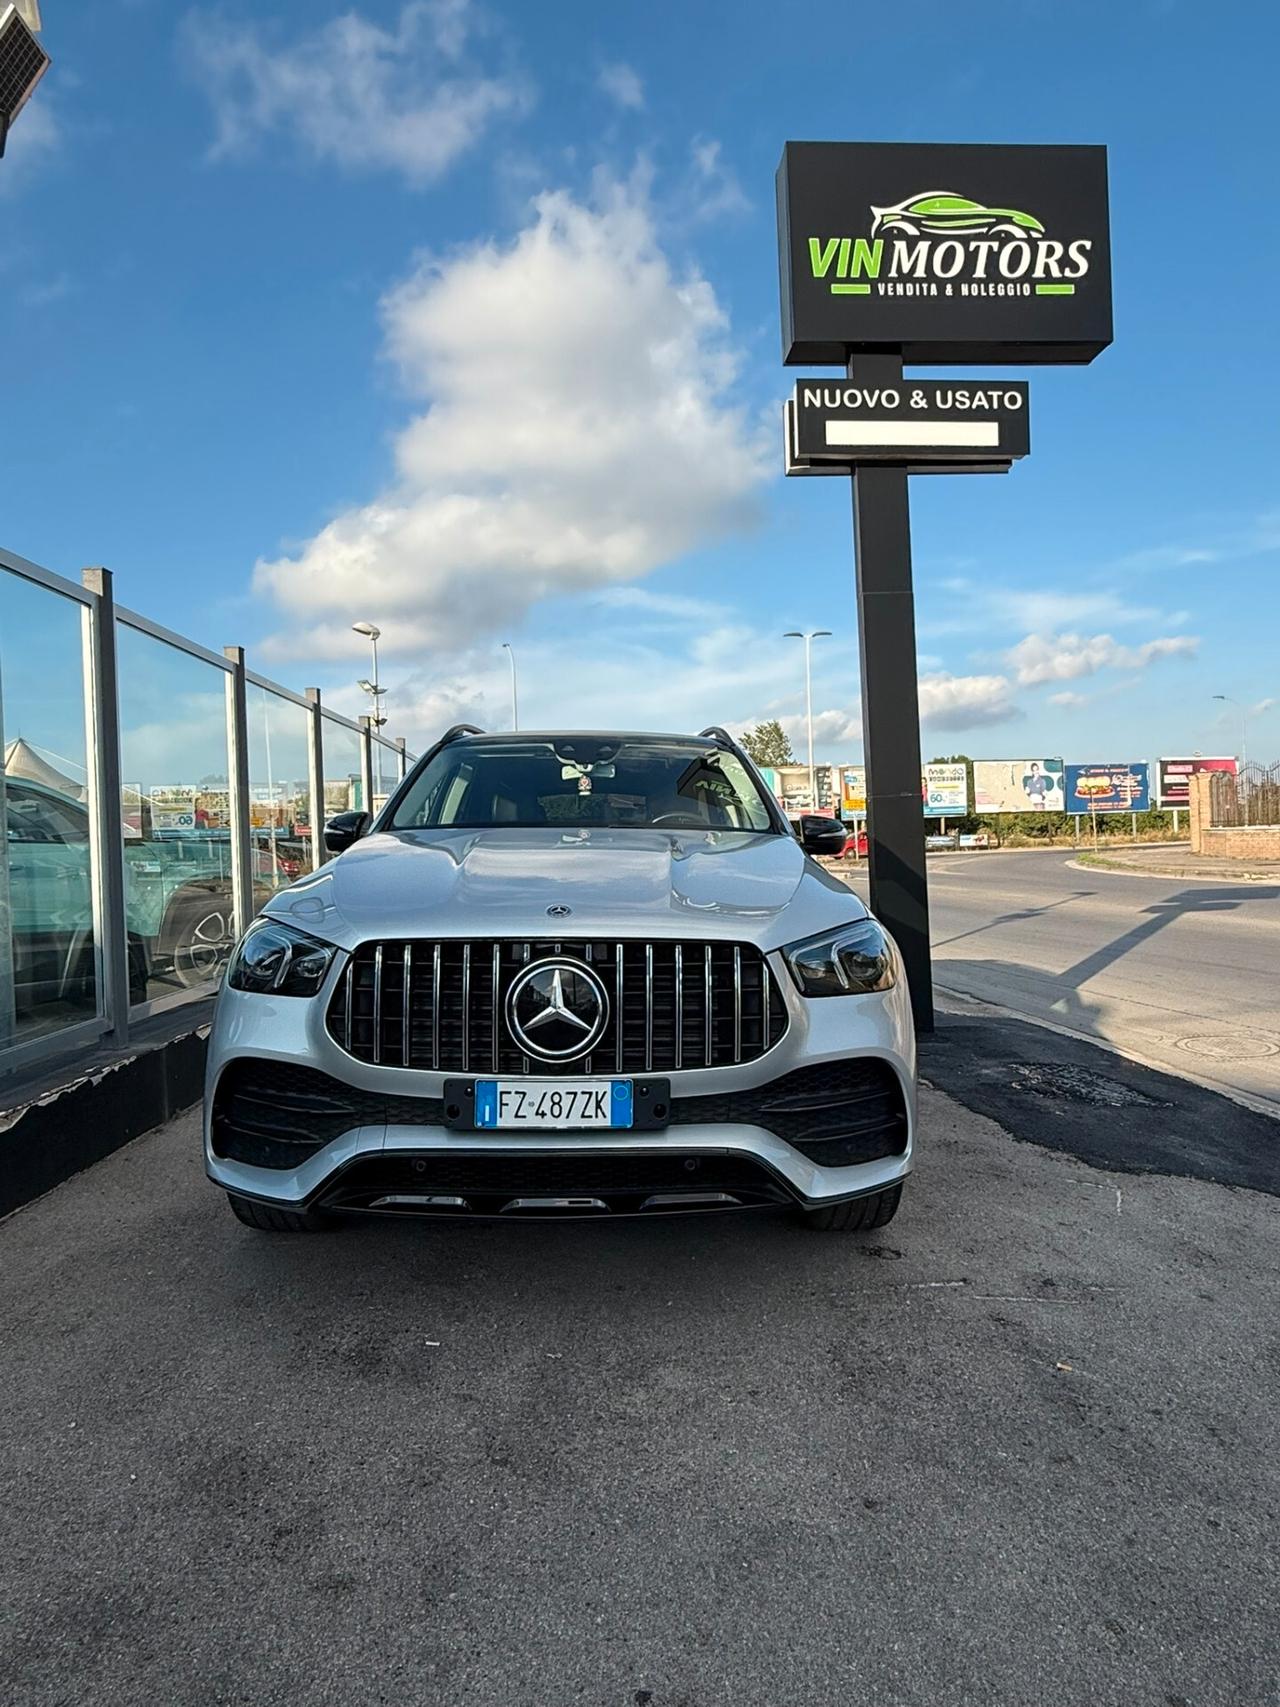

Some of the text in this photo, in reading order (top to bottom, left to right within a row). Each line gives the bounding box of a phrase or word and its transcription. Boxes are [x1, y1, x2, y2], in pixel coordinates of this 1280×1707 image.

[878, 282, 1031, 296] VENDITA & NOLEGGIO
[803, 388, 1023, 410] NUOVO & USATO
